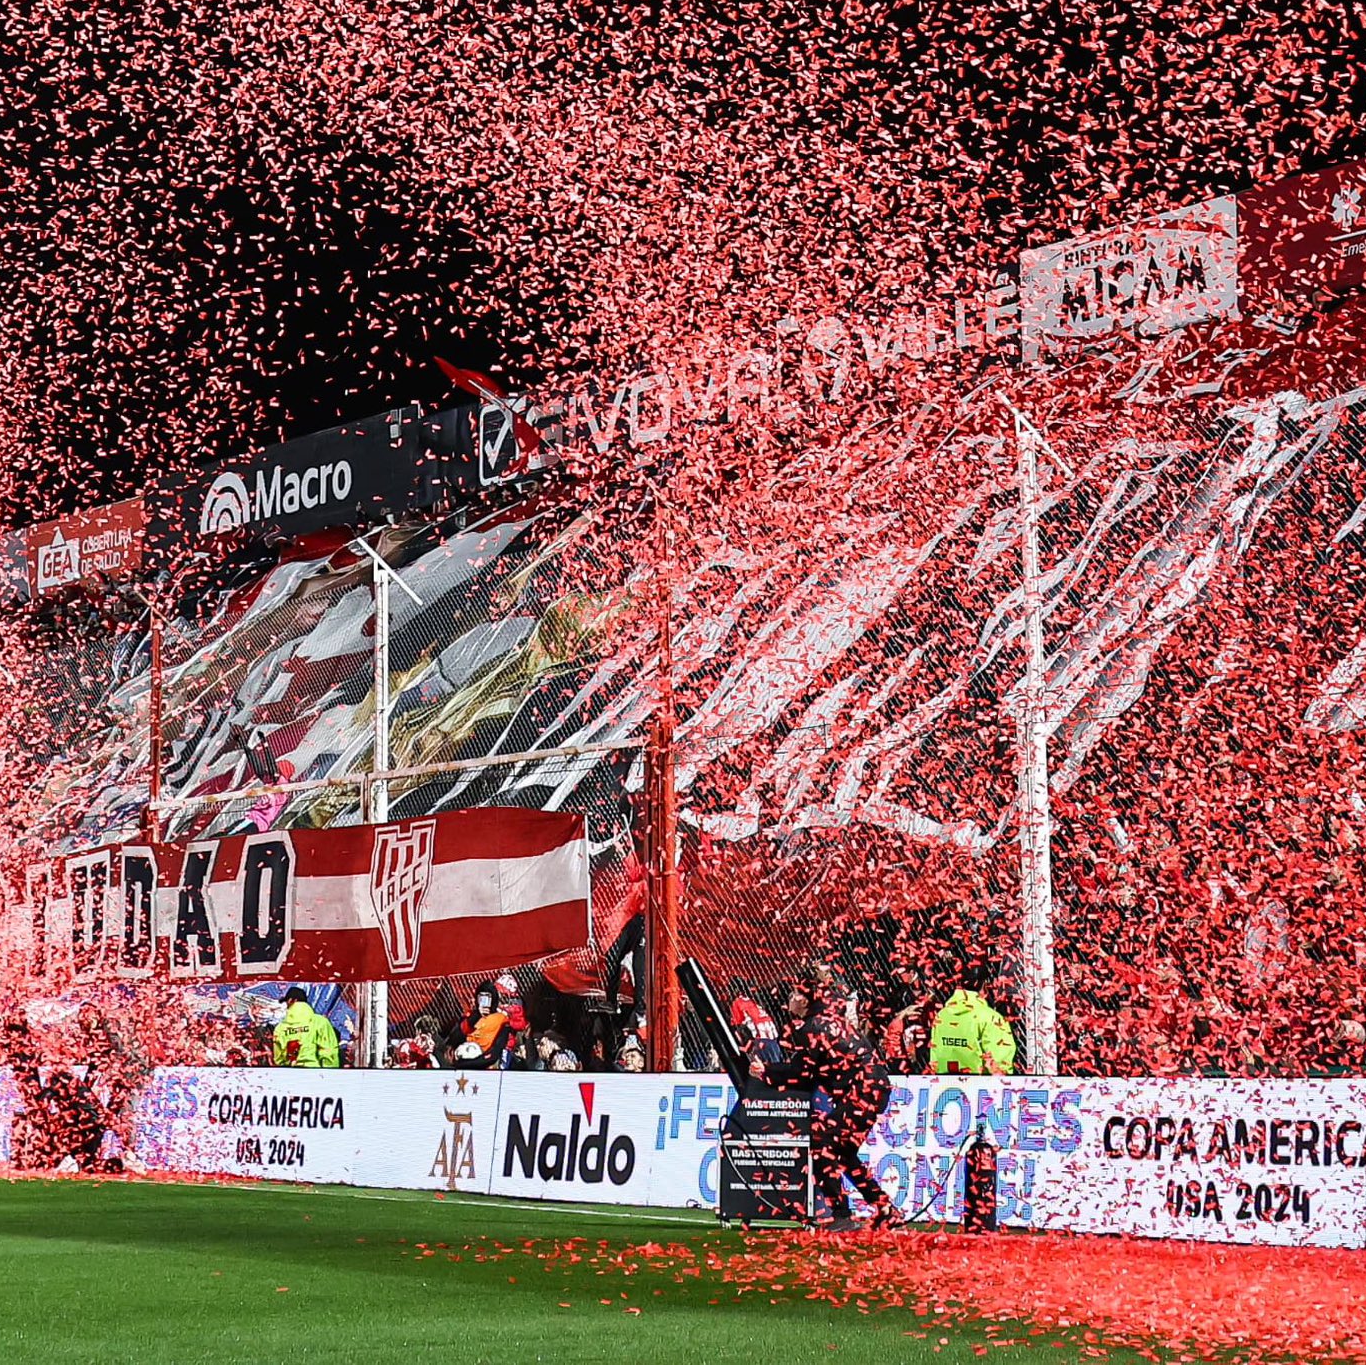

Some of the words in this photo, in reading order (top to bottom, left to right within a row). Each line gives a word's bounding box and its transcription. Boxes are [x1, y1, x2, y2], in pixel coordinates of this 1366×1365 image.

[254, 460, 352, 522] Macro
[81, 528, 133, 555] COBERTURA
[42, 549, 73, 581] GEA
[81, 557, 93, 575] DE
[94, 551, 121, 571] SALUD
[941, 1036, 968, 1048] TISEG
[208, 1093, 254, 1127] COPA
[257, 1094, 345, 1129] AMERICA
[236, 1137, 263, 1165] USA
[268, 1139, 305, 1167] 2024
[503, 1113, 636, 1186] Naldo
[1103, 1115, 1199, 1163] COPA
[1166, 1179, 1223, 1222] USA
[1236, 1183, 1310, 1223] 2024
